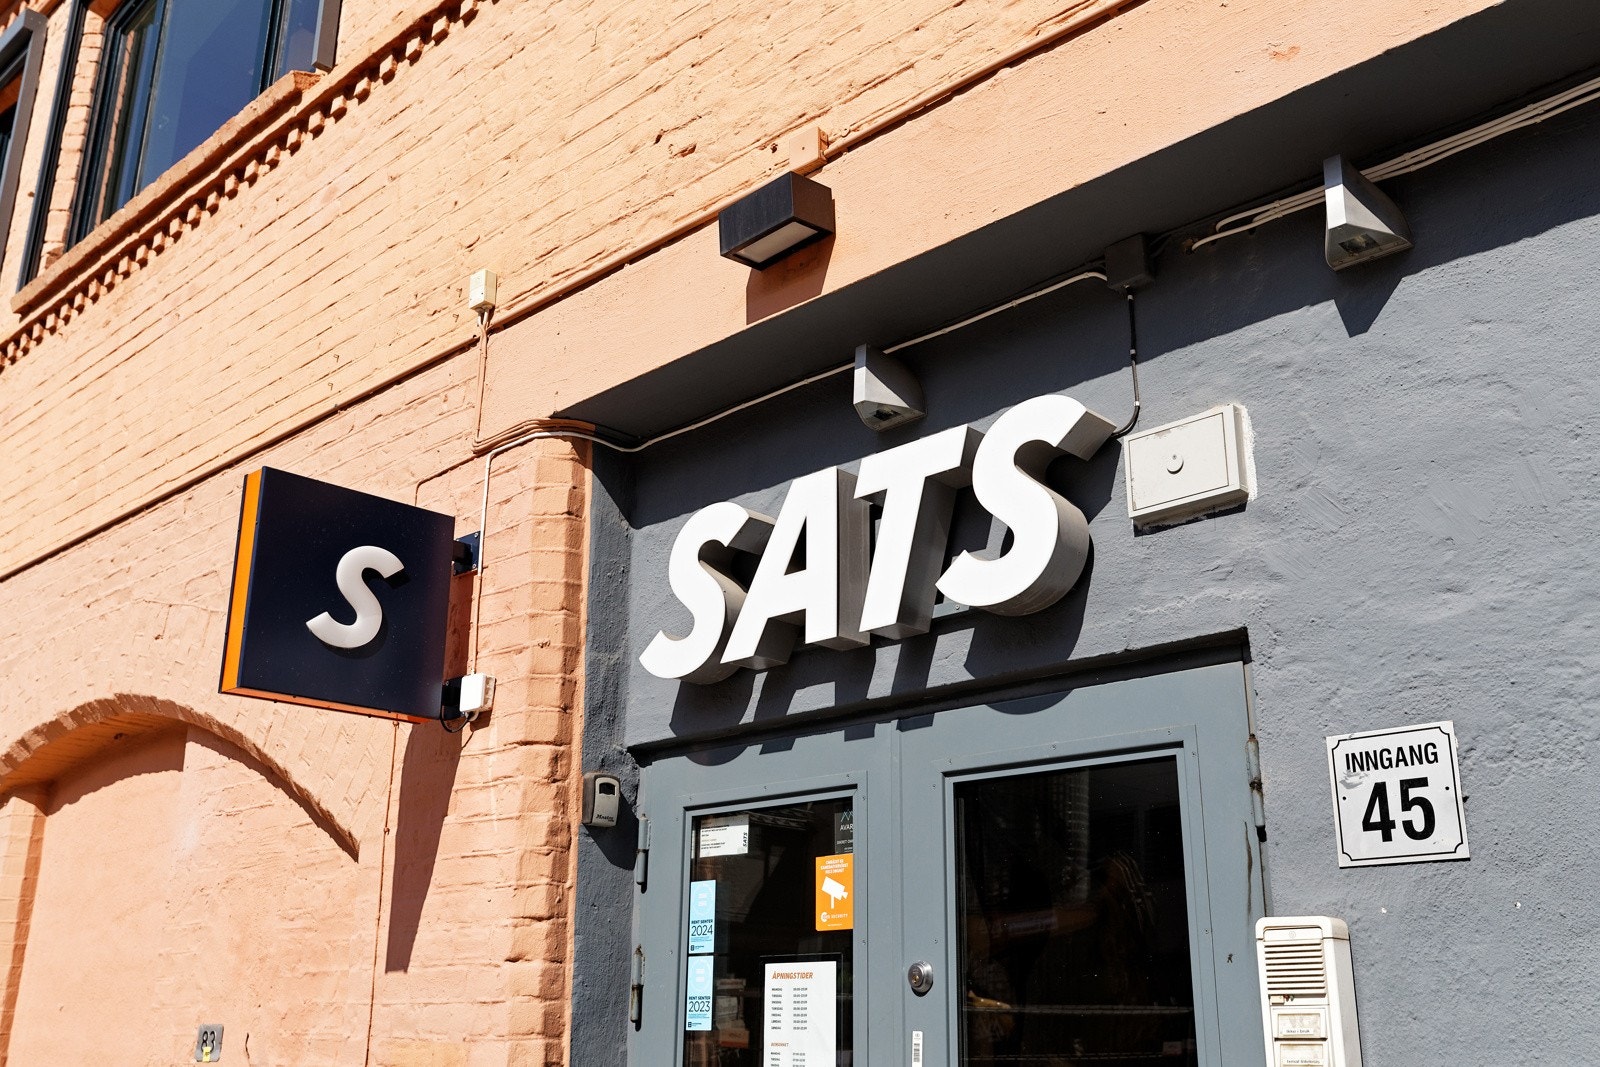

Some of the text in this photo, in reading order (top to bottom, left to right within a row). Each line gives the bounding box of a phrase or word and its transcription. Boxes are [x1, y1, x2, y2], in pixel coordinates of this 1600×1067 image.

[639, 395, 1092, 682] SATS
[305, 545, 405, 649] S
[1345, 742, 1439, 773] INNGANG
[1362, 776, 1436, 843] 45
[691, 925, 713, 936] 2024
[771, 971, 813, 980] ÅPNINGSTIDER
[688, 1001, 710, 1012] 2023
[201, 1031, 215, 1053] 83
